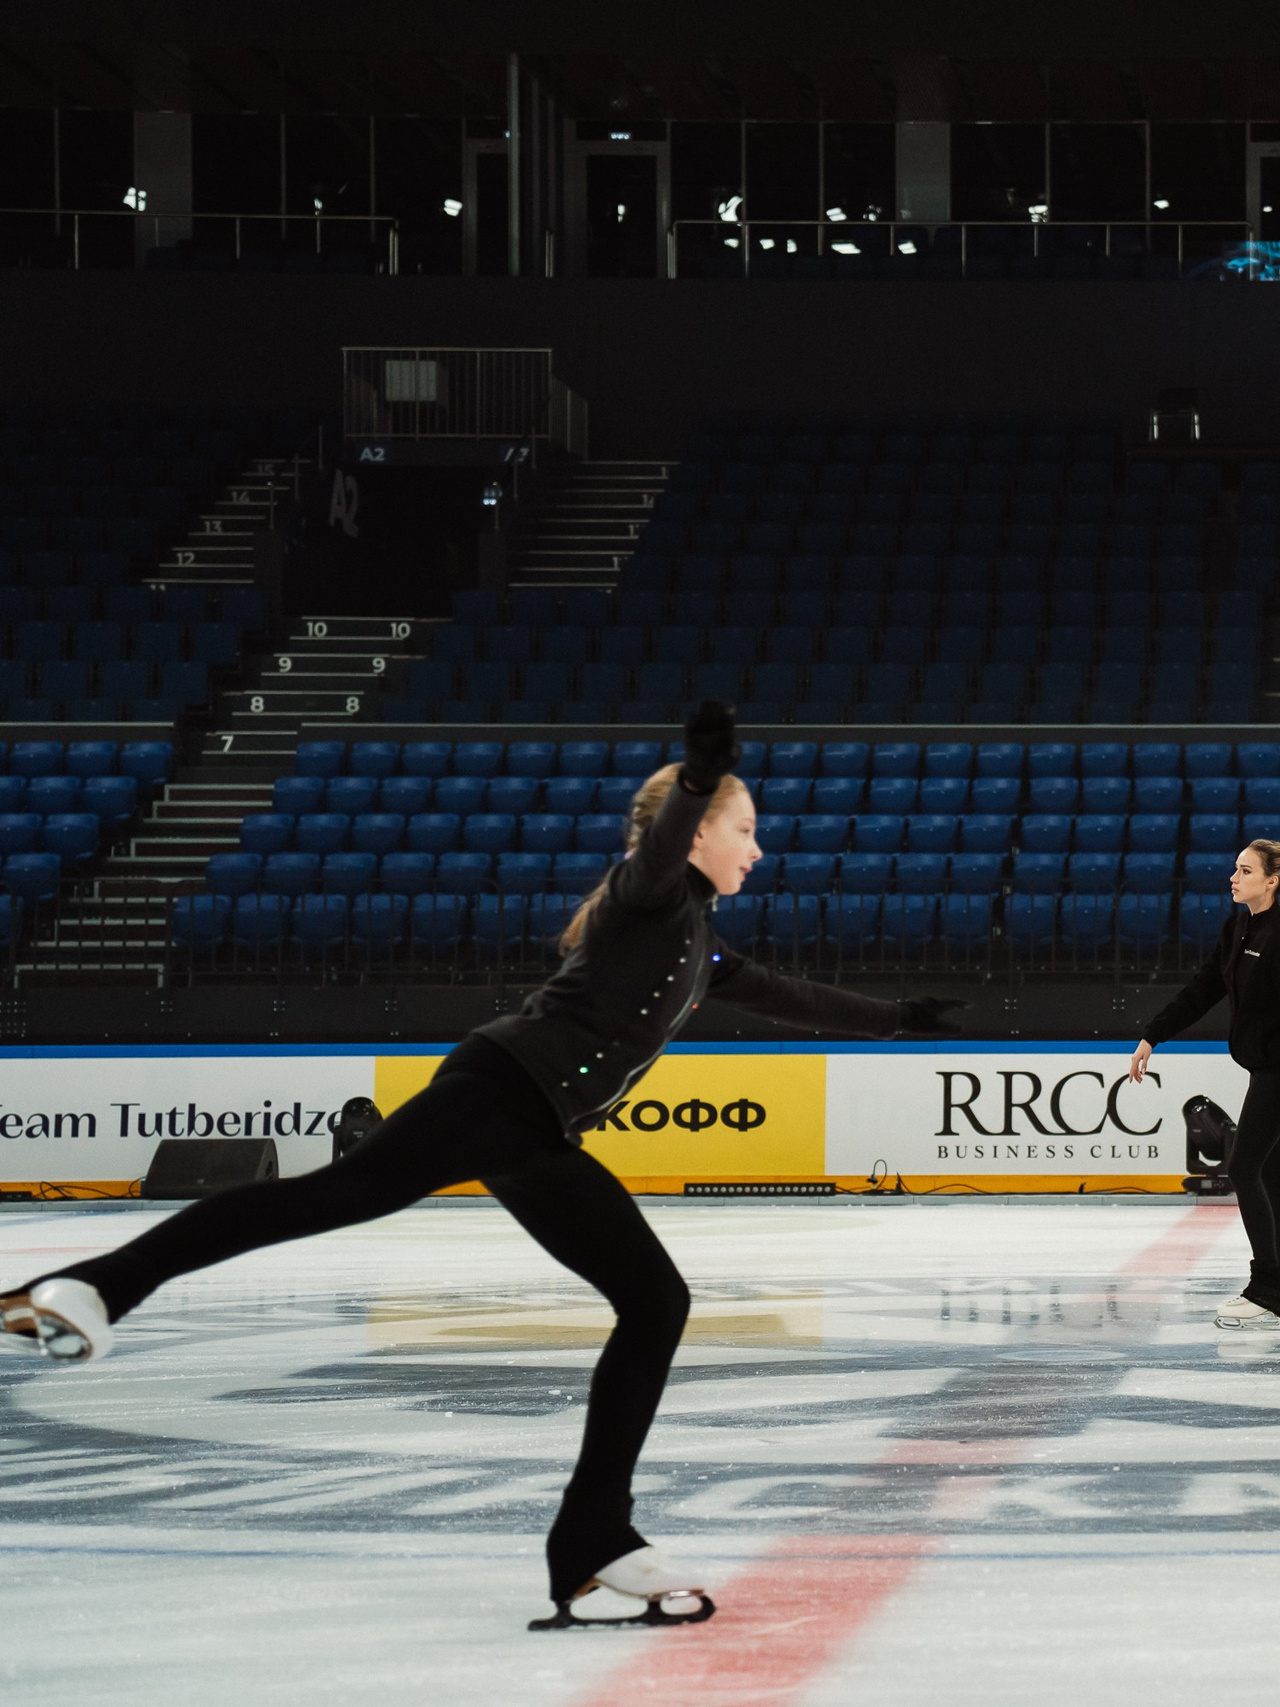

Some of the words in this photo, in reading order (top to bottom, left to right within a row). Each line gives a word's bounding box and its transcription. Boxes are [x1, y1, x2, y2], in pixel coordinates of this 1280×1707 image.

[360, 447, 386, 462] A2
[204, 520, 222, 534] 13
[177, 552, 195, 567] 12
[307, 621, 328, 638] 10
[390, 622, 411, 639] 10
[278, 656, 292, 673] 9
[372, 657, 386, 673] 9
[249, 696, 264, 714] 8
[345, 696, 360, 714] 8
[221, 735, 235, 752] 7
[934, 1070, 1163, 1137] RRCC
[0, 1103, 97, 1139] eam
[936, 1144, 1074, 1159] BUSINESS
[1090, 1144, 1161, 1159] CLUB
